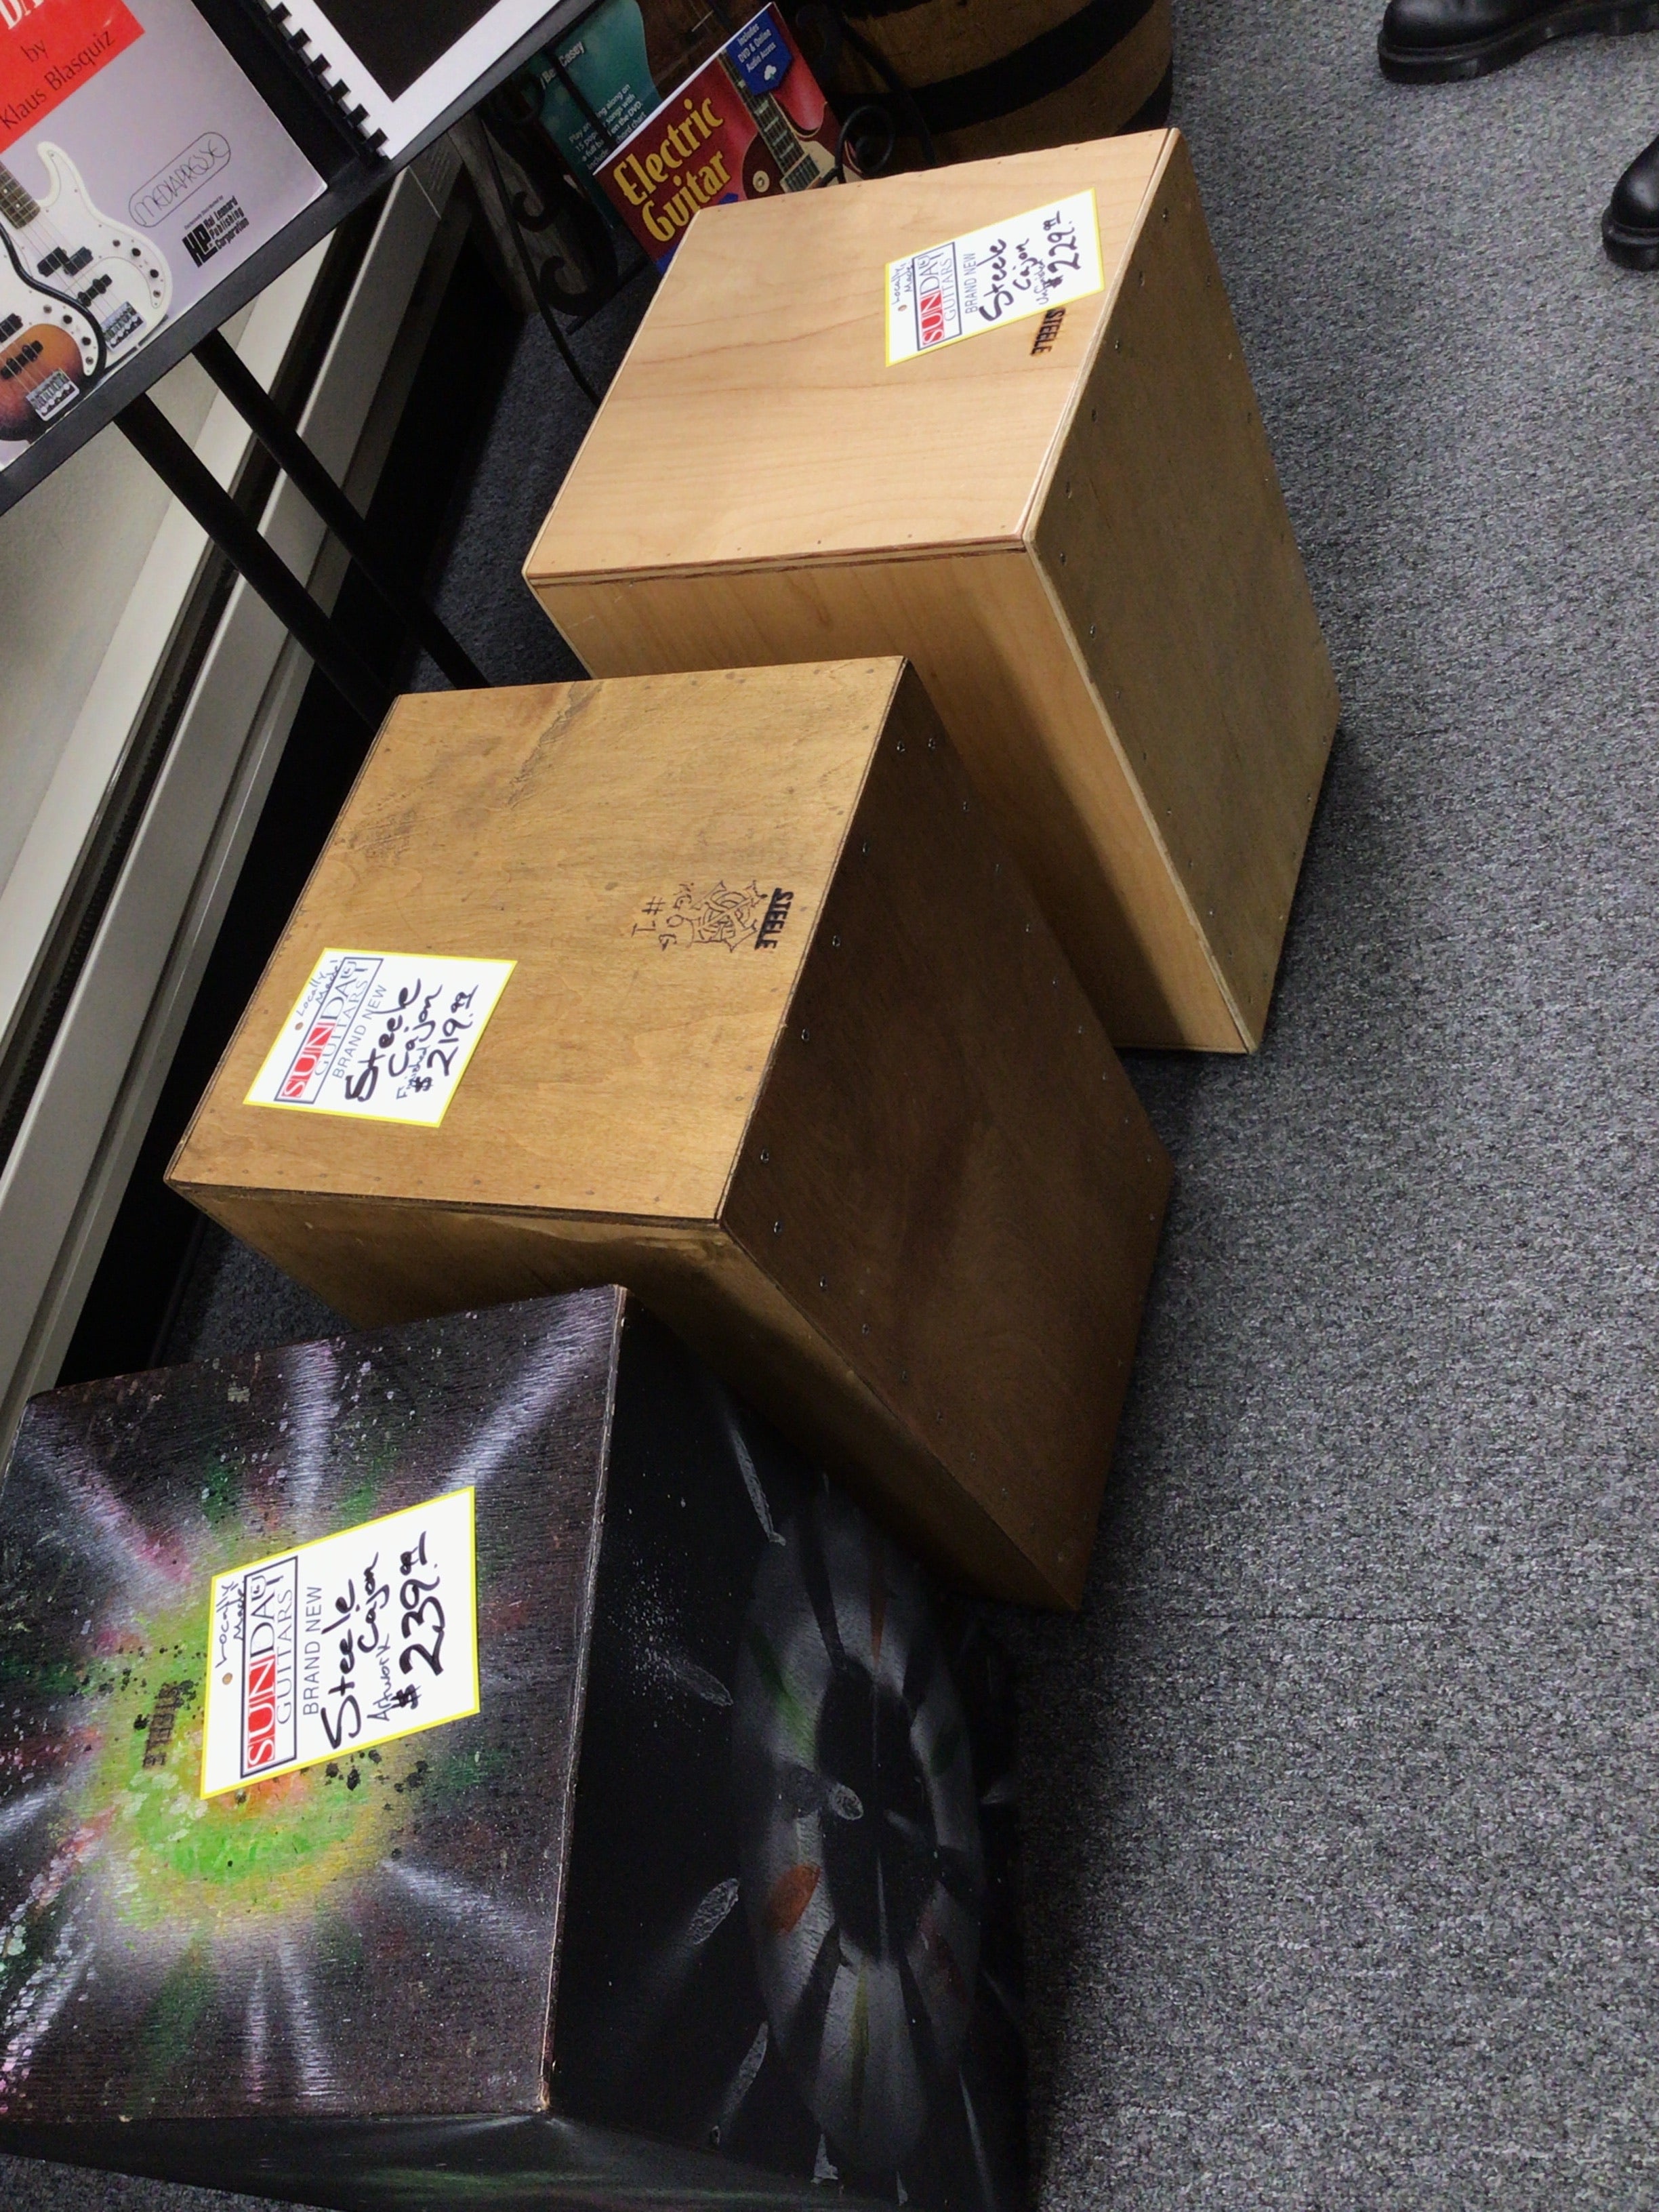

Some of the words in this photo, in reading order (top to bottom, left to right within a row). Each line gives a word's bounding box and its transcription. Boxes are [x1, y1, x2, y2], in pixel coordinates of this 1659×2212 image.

[0, 89, 47, 130] Klaus
[44, 30, 115, 91] Blasquiz
[20, 40, 48, 62] by
[558, 41, 585, 66] Casey
[737, 47, 751, 63] DVD
[606, 106, 623, 123] songs
[622, 94, 636, 108] with
[607, 91, 623, 109] along
[618, 115, 629, 126] the
[613, 98, 724, 205] Electric
[642, 150, 731, 242] Guitar
[919, 253, 944, 346] SUNDAY
[940, 258, 956, 321] GUITARS
[963, 253, 977, 276] NEW
[964, 278, 978, 314] BRAND
[979, 239, 1014, 321] Steele
[1012, 238, 1043, 290] Cajon
[1029, 308, 1066, 356] STEELE
[754, 888, 794, 951] STEELE
[281, 961, 368, 1098] SUNDAY
[296, 969, 327, 1017] Locally
[314, 979, 369, 1076] GUITARS
[333, 1025, 367, 1079] BRAND
[362, 984, 387, 1021] NEW
[388, 984, 443, 1078] Cajon
[345, 978, 422, 1102] Steele
[216, 1580, 237, 1668] Locally
[306, 1586, 323, 1633] NEW
[356, 1552, 390, 1653] Cajon
[247, 1574, 284, 1769] SUNDAY
[276, 1589, 293, 1725] GUITARS
[303, 1642, 321, 1715] BRAND
[321, 1579, 362, 1750] Steele
